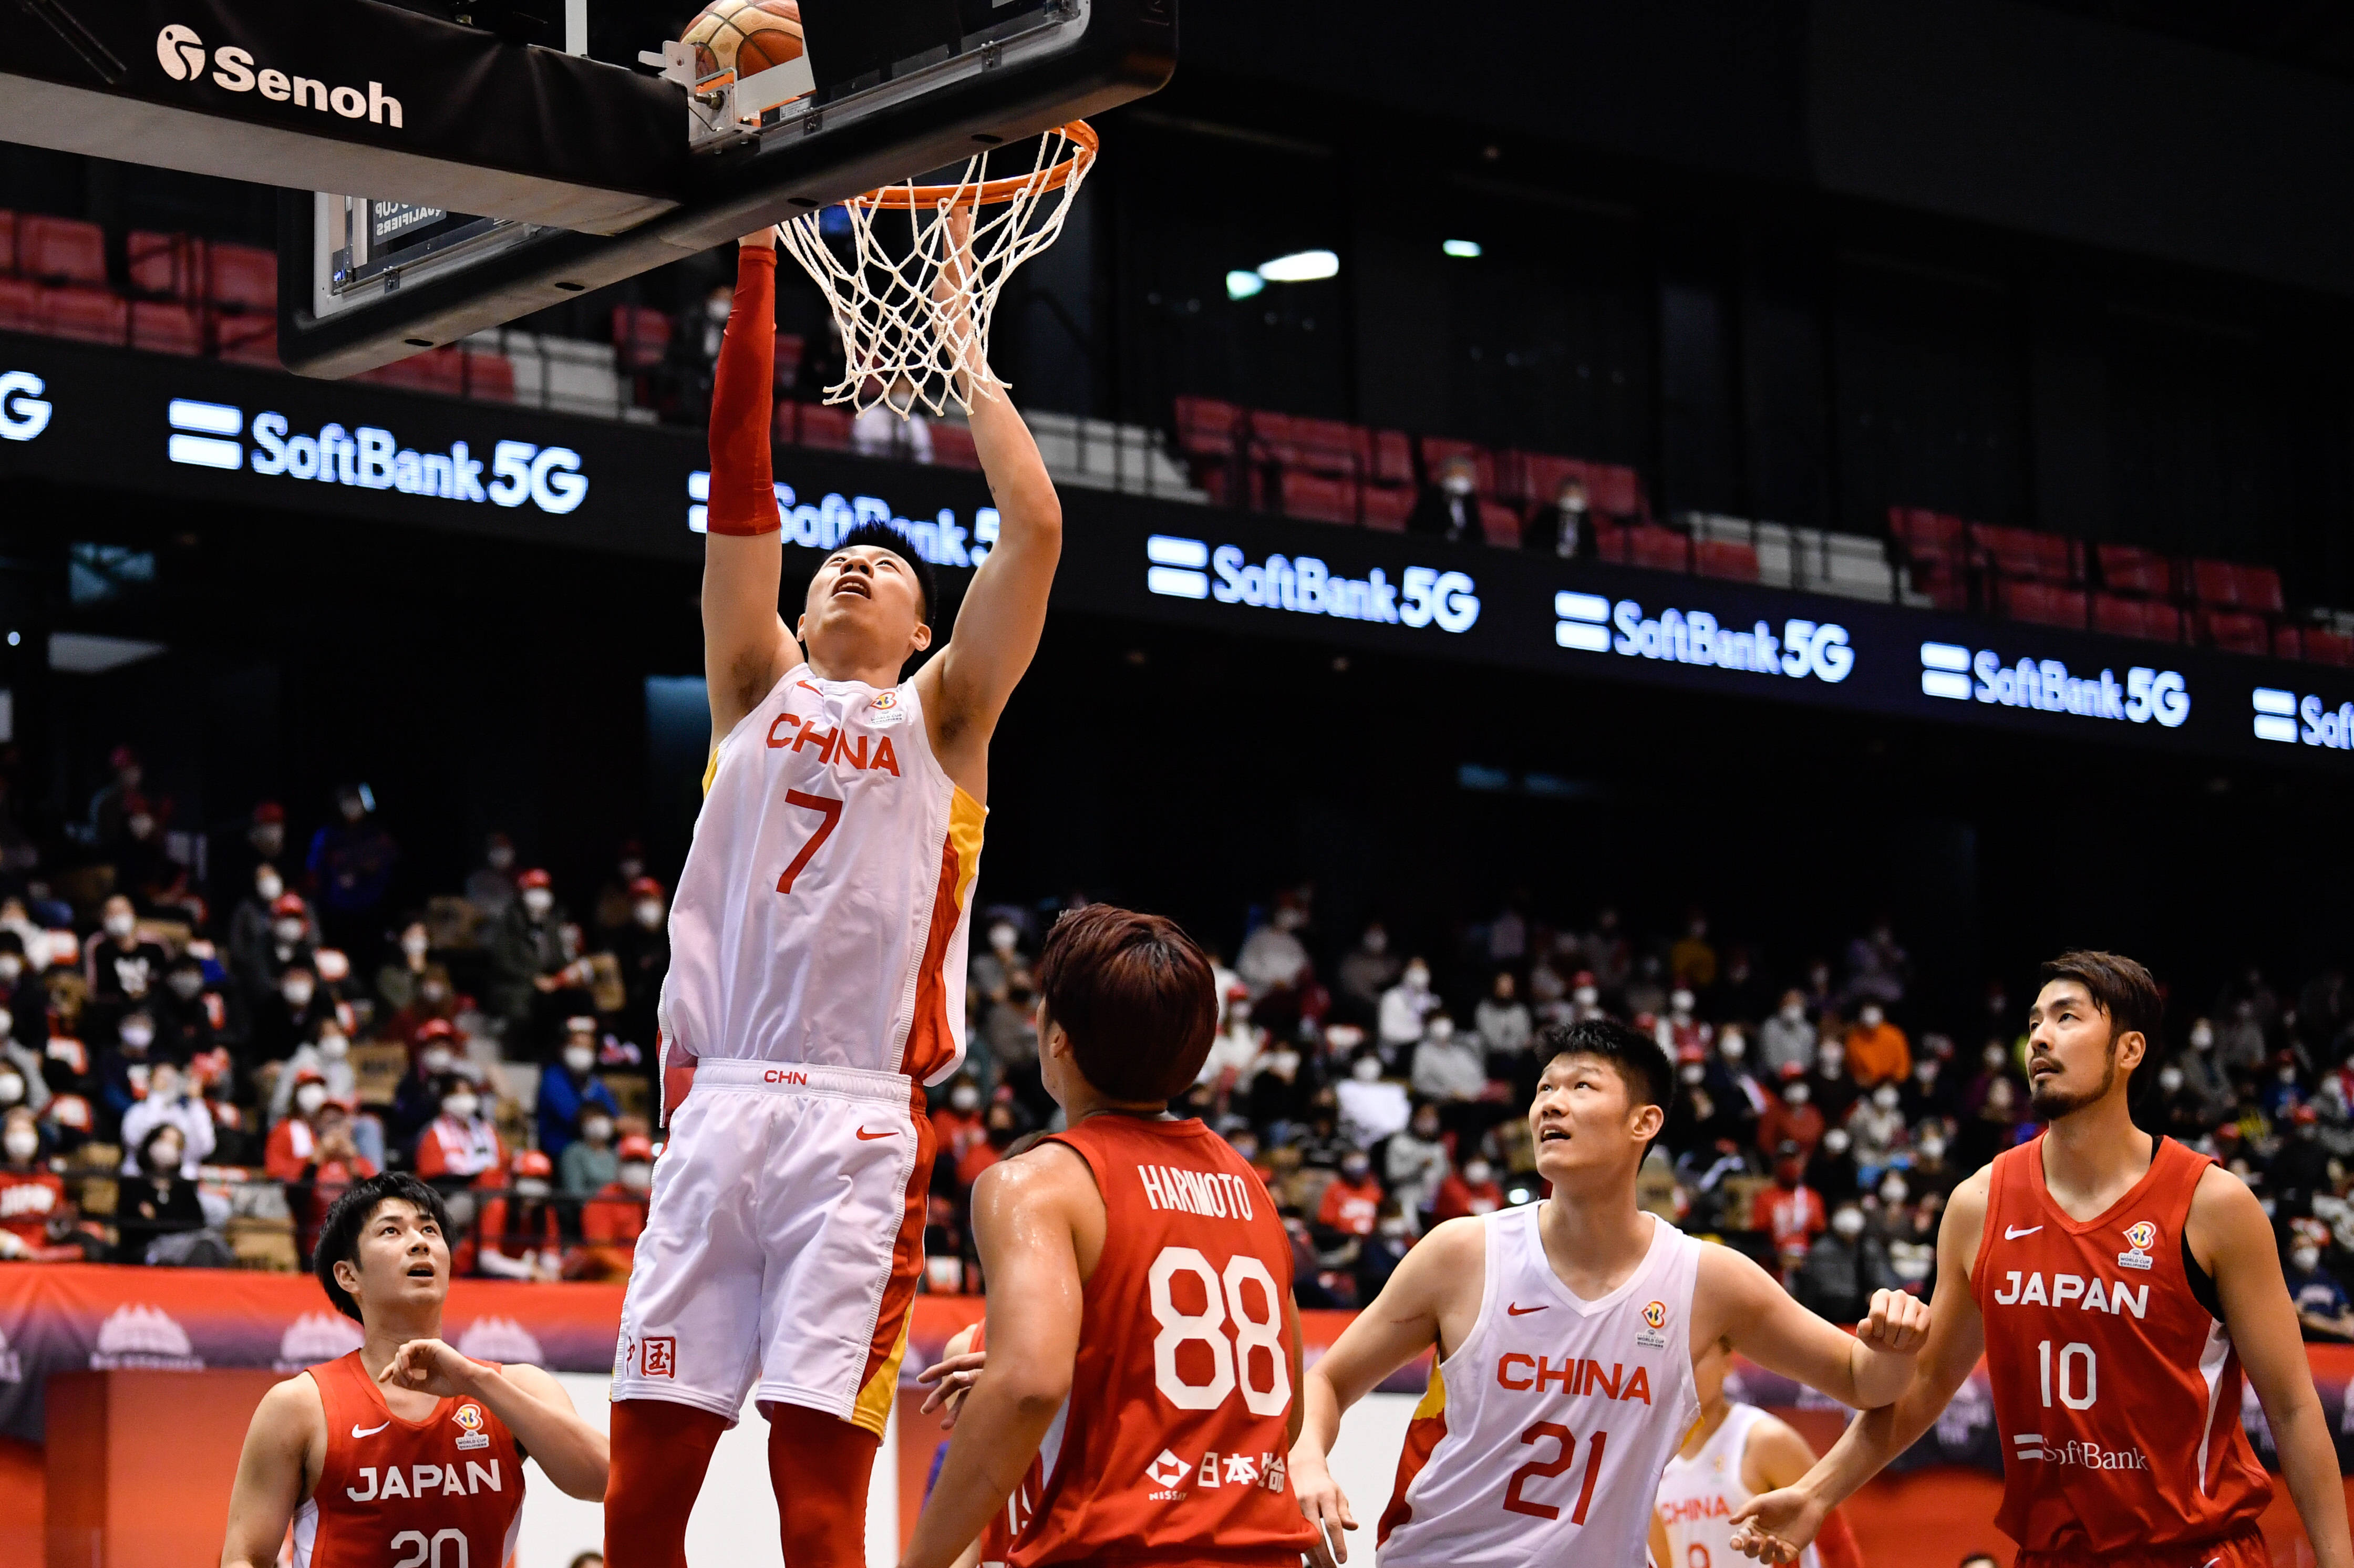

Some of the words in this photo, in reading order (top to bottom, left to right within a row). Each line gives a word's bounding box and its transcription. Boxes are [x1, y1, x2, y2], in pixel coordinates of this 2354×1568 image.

[212, 46, 403, 128] Senoh
[250, 411, 487, 502] SoftBank
[487, 439, 589, 514] 5G
[1211, 544, 1399, 624] SoftBank
[1399, 565, 1481, 633] 5G
[1612, 599, 1781, 675] SoftBank
[1781, 618, 1855, 683] 5G
[1971, 649, 2126, 720] SoftBank
[2125, 666, 2191, 728] 5G
[766, 713, 901, 777] CHNA
[776, 788, 843, 894] 7
[764, 1070, 808, 1086] CHN
[1137, 1164, 1253, 1221] HARIMOTO
[1995, 1271, 2149, 1319] JAPAN
[1149, 1246, 1291, 1417] 88
[1496, 1352, 1651, 1405] CHINA
[2038, 1340, 2097, 1410] 10
[347, 1459, 502, 1502] JAPAN
[1503, 1421, 1608, 1526] 21
[2043, 1438, 2149, 1471] SoftBank
[1661, 1495, 1731, 1525] CHINA
[390, 1528, 468, 1568] 20
